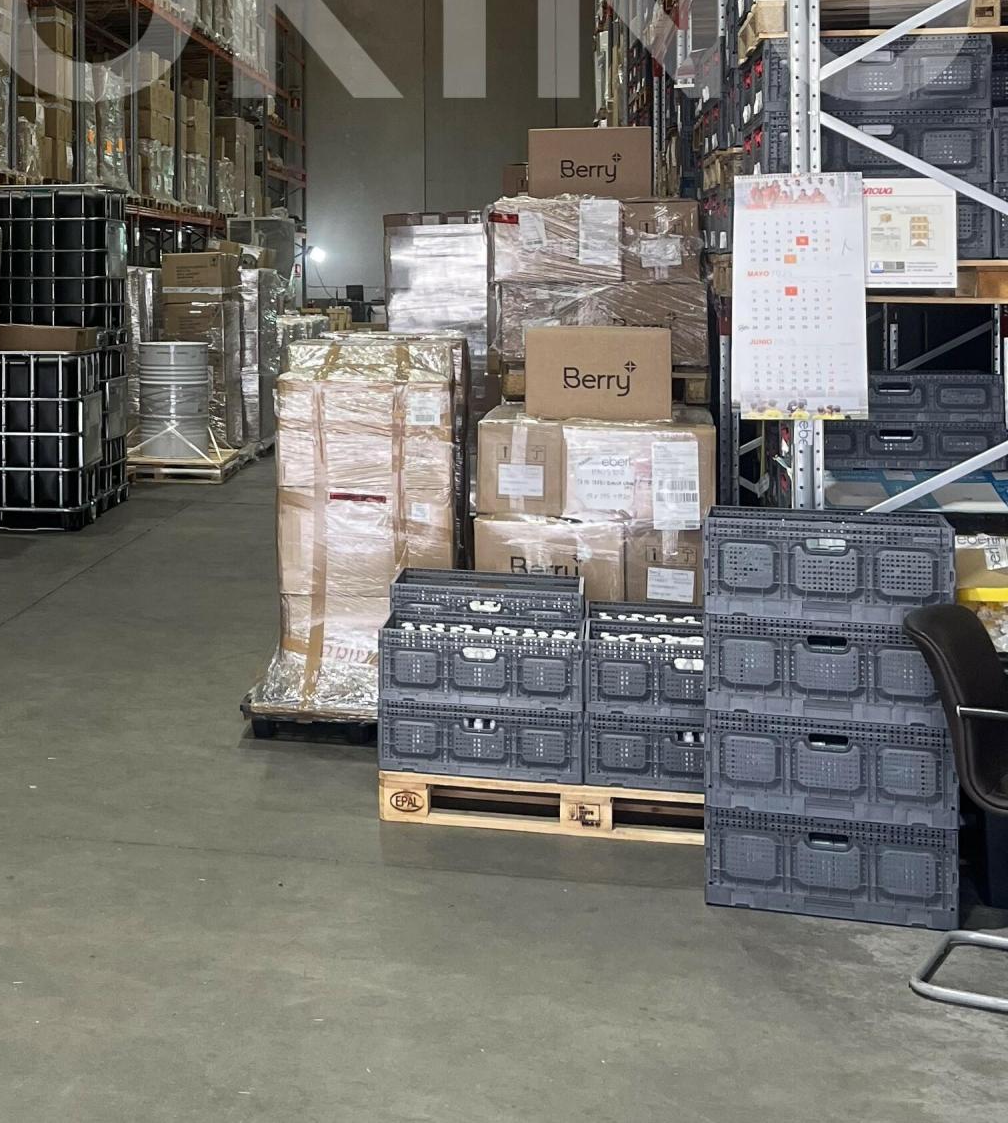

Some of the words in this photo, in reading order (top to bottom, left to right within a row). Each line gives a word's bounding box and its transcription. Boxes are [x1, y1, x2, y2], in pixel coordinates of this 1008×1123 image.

[560, 159, 617, 183] Berry
[750, 338, 774, 346] JUNIO
[563, 366, 631, 397] Berry
[395, 795, 420, 808] EPAL
